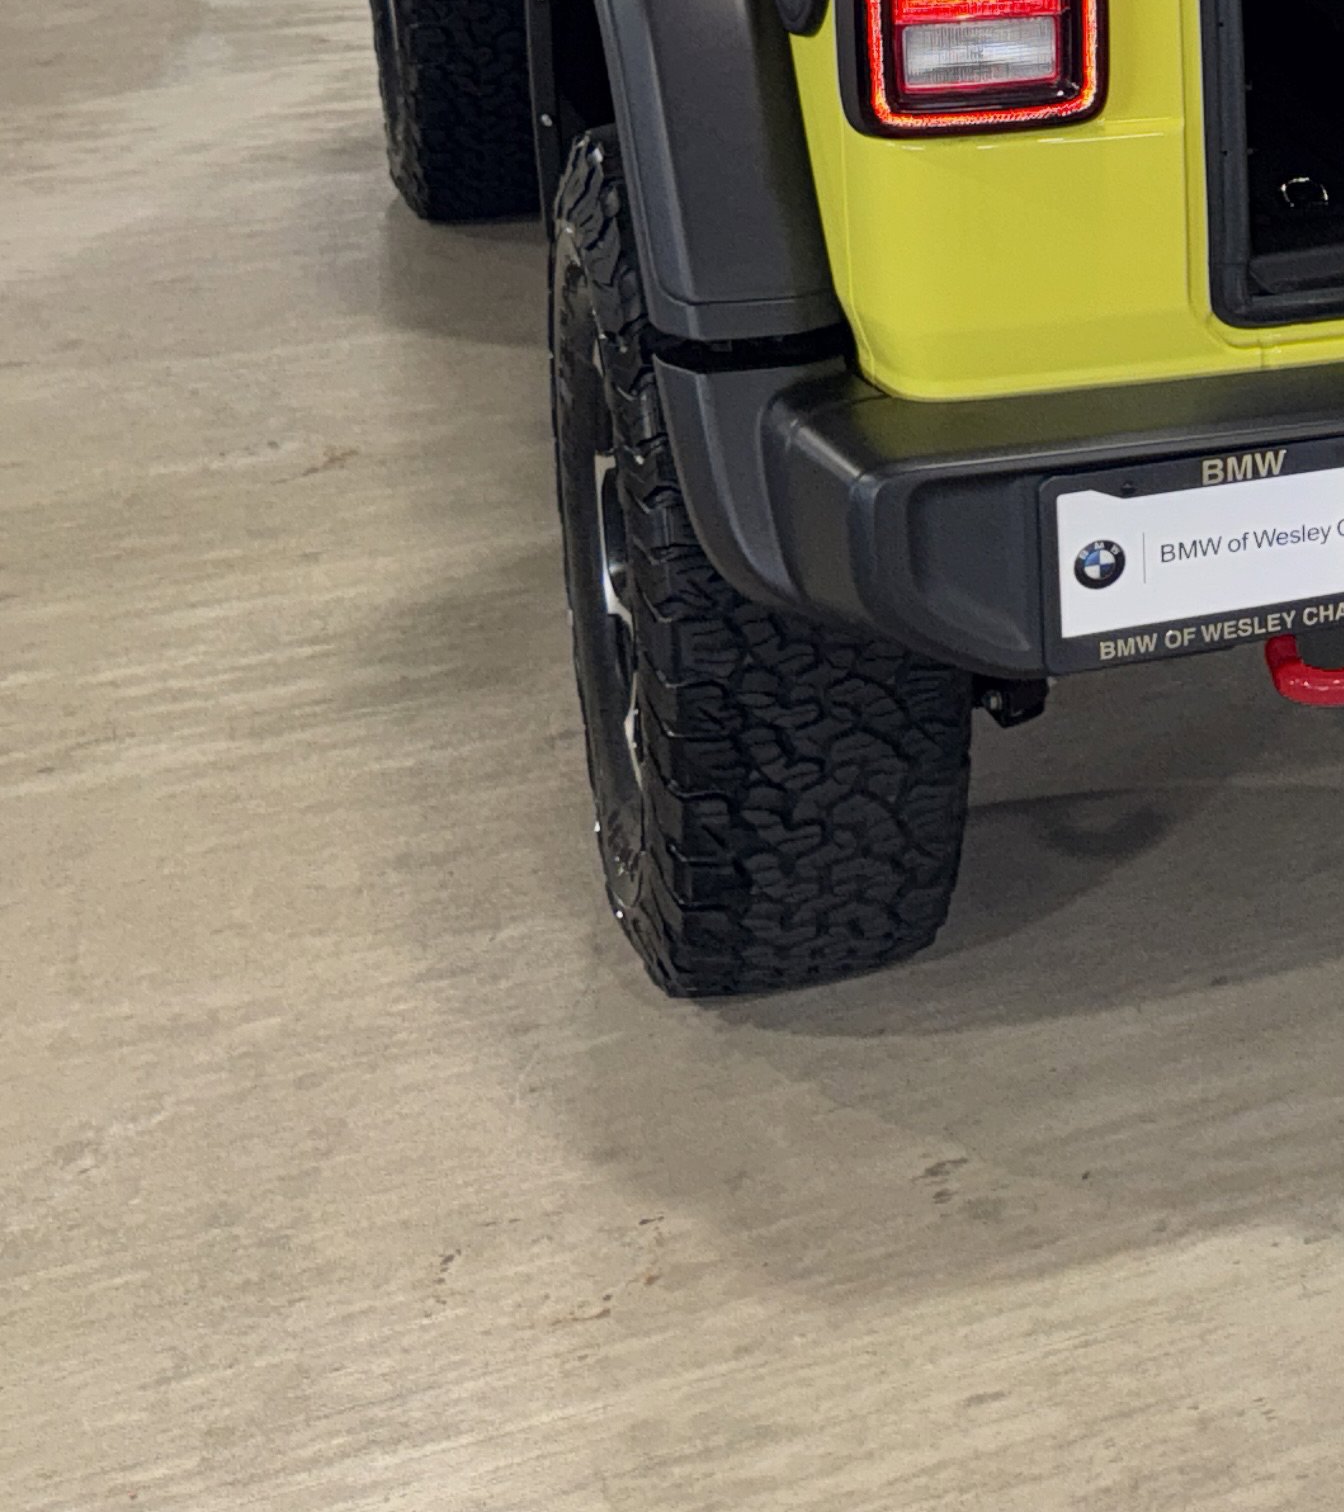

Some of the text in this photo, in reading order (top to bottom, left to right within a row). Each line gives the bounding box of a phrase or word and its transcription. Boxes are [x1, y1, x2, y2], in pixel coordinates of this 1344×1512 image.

[1201, 449, 1288, 486] BMW
[1160, 536, 1222, 563] BMW
[1227, 532, 1249, 553] of
[1253, 524, 1332, 549] Wesley
[1099, 633, 1157, 660] BMW
[1164, 627, 1196, 649] OF
[1201, 610, 1297, 643] WESLEY
